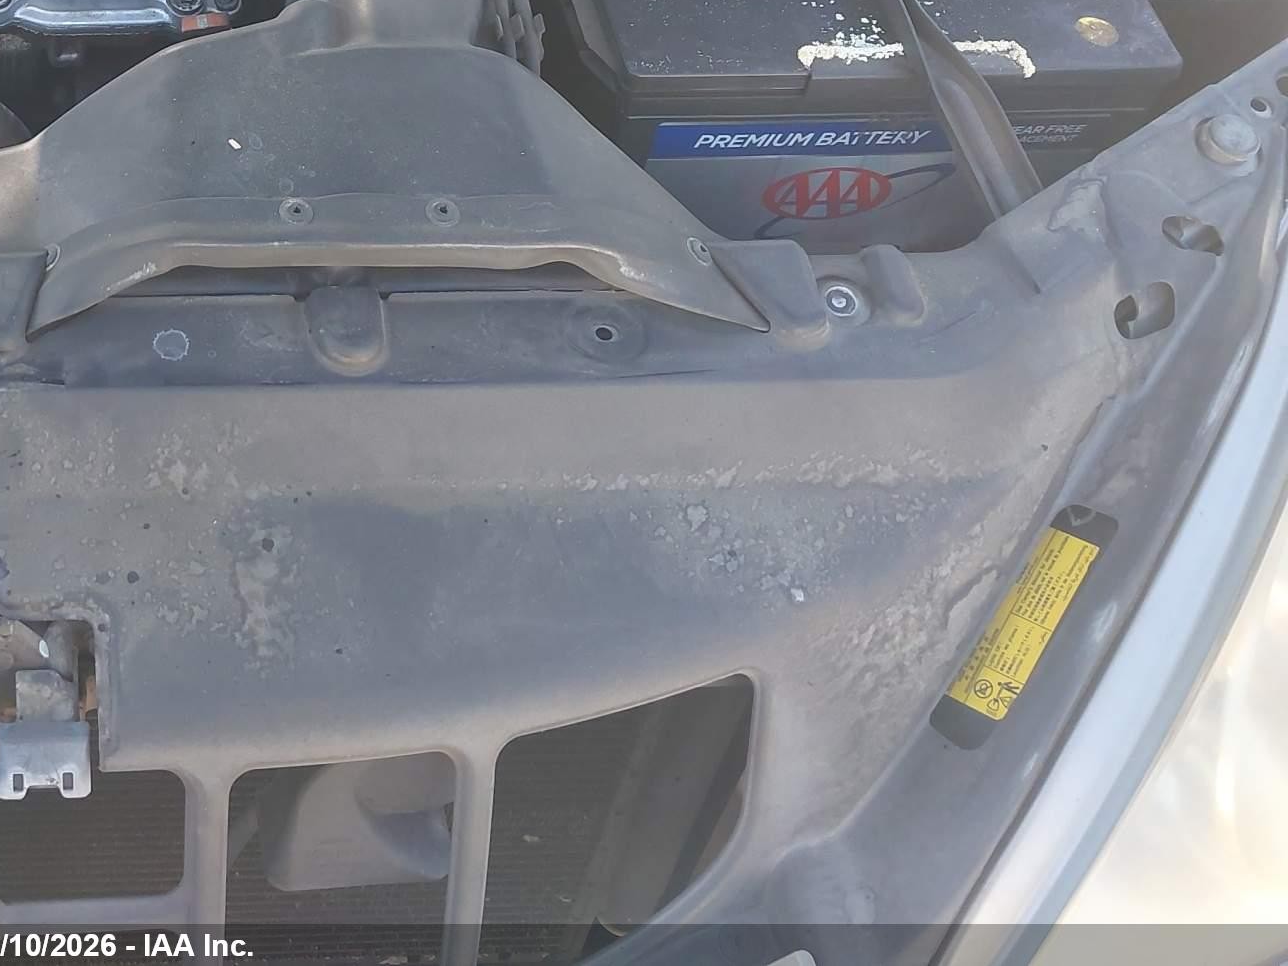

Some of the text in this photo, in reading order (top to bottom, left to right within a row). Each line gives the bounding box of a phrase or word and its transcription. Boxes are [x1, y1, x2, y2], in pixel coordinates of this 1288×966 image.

[1011, 123, 1088, 134] EAR FREE
[693, 129, 932, 149] PREMIUM BATTERY
[1019, 134, 1079, 143] ACEMENT
[768, 167, 886, 219] AAA
